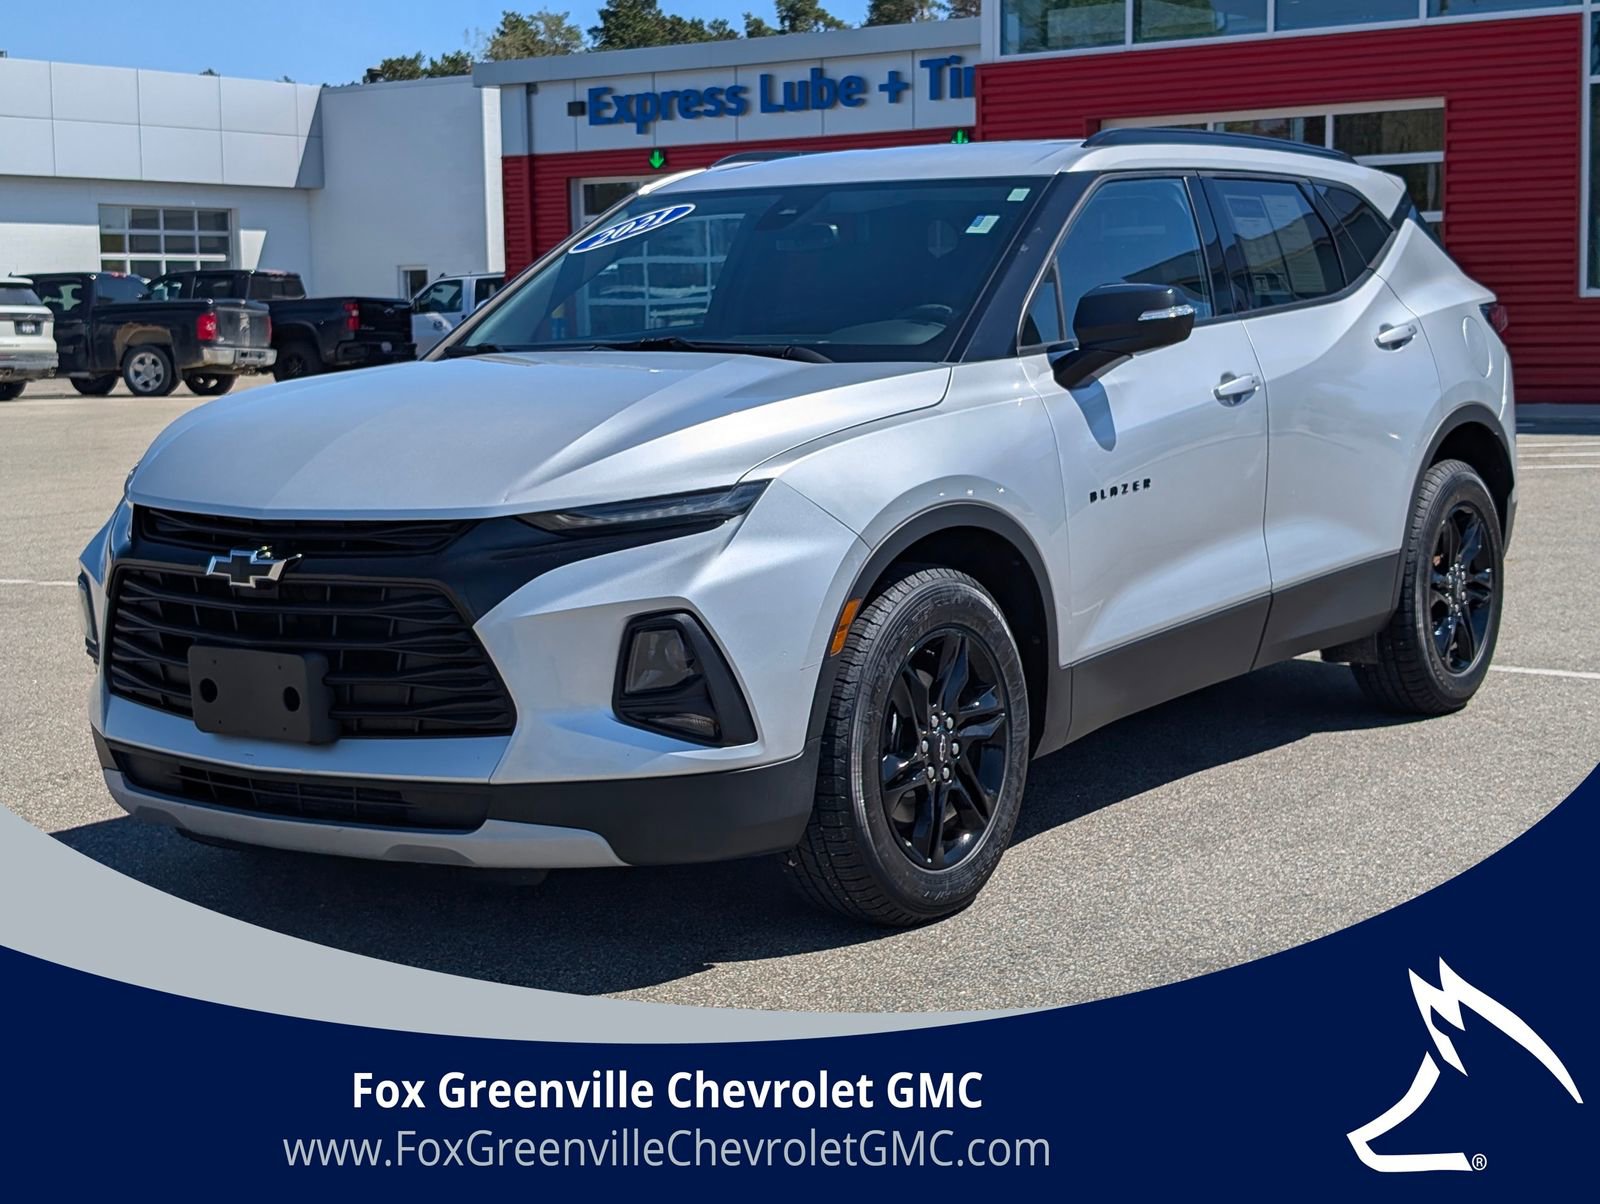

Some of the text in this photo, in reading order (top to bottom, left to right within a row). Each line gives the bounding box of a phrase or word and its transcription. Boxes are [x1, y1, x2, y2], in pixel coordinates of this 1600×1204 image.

[587, 84, 748, 135] Express
[759, 67, 866, 114] Lube
[587, 208, 676, 248] 2021
[1089, 478, 1151, 504] BLAZER
